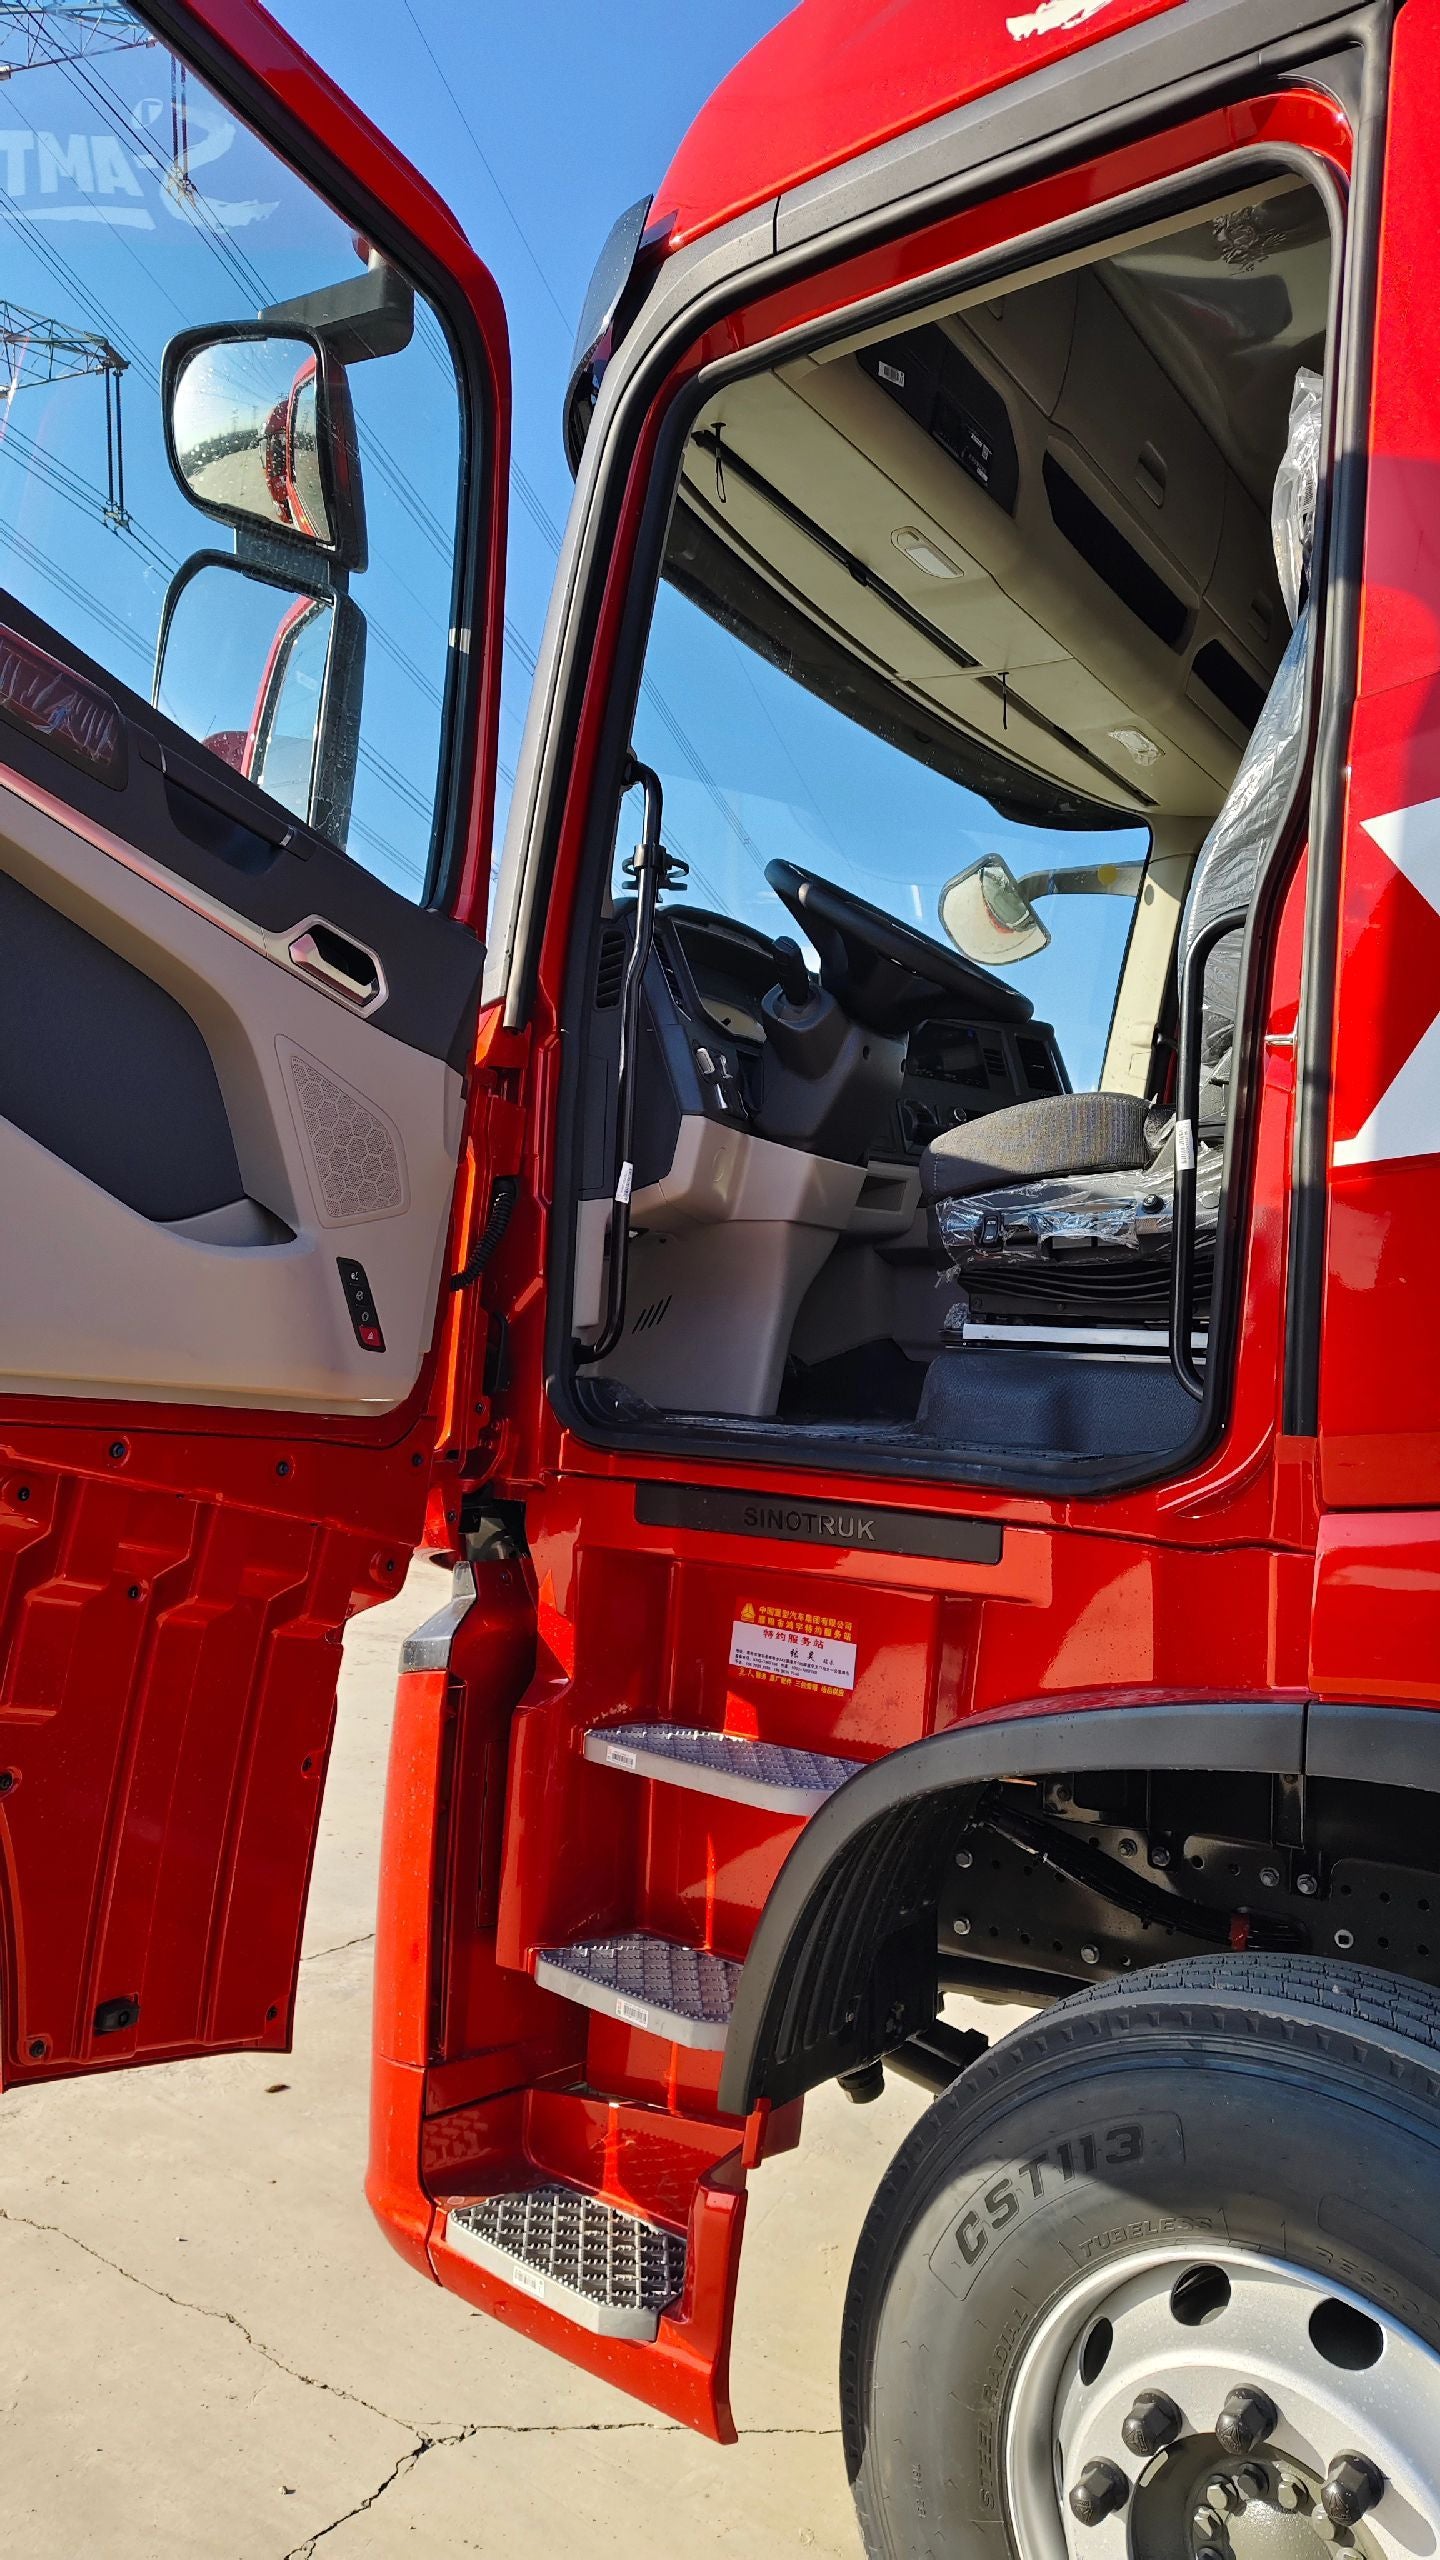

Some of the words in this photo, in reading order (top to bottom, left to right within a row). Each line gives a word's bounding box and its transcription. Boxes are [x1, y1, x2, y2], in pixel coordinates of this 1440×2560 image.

[743, 1506, 876, 1541] SINOTRUK
[762, 1628, 824, 1649] 特约服务站
[955, 2123, 1144, 2266] CST113
[1078, 2217, 1213, 2258] TUBELESS
